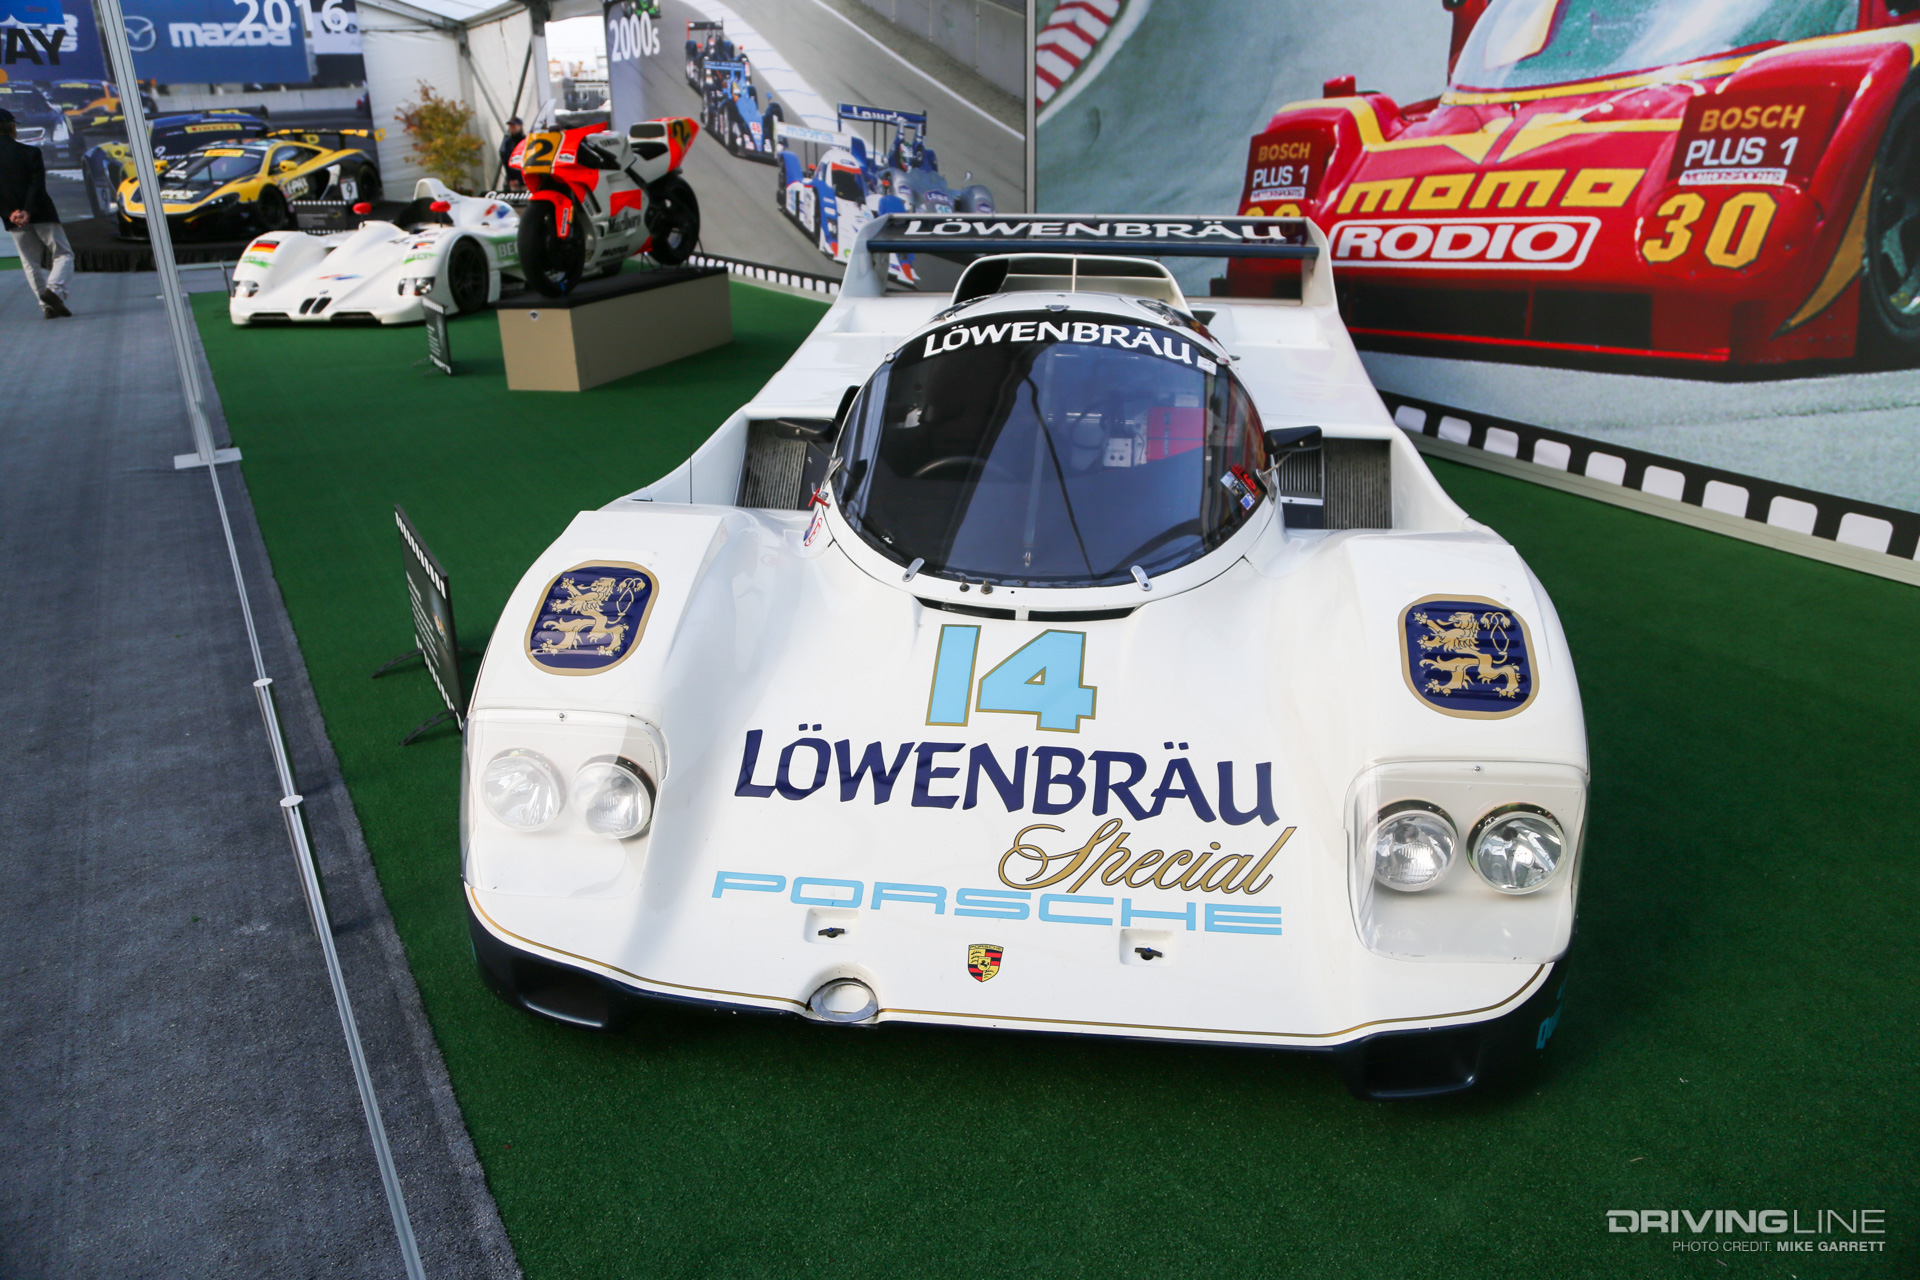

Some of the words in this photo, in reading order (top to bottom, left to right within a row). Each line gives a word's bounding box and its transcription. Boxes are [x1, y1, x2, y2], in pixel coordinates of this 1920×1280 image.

[234, 0, 350, 32] 2016
[609, 11, 660, 62] 2000s
[672, 119, 692, 147] 2
[1699, 105, 1807, 132] BOSCH
[525, 138, 553, 166] 2
[1258, 142, 1311, 162] BOSCH
[1684, 136, 1767, 167] PLUS
[1780, 137, 1799, 166] 1
[1252, 165, 1293, 188] PLUS
[1299, 165, 1310, 185] 1
[1336, 168, 1648, 214] momo
[904, 218, 1288, 240] LÖWENBRÄU
[1336, 223, 1578, 260] RODIO
[1641, 191, 1778, 269] 30
[923, 321, 1193, 365] LÖWENBRÄU
[925, 623, 1098, 734] 14
[734, 723, 1280, 825] LÖWENBRÄU
[998, 818, 1298, 894] Special
[712, 871, 1283, 936] PORSCHE
